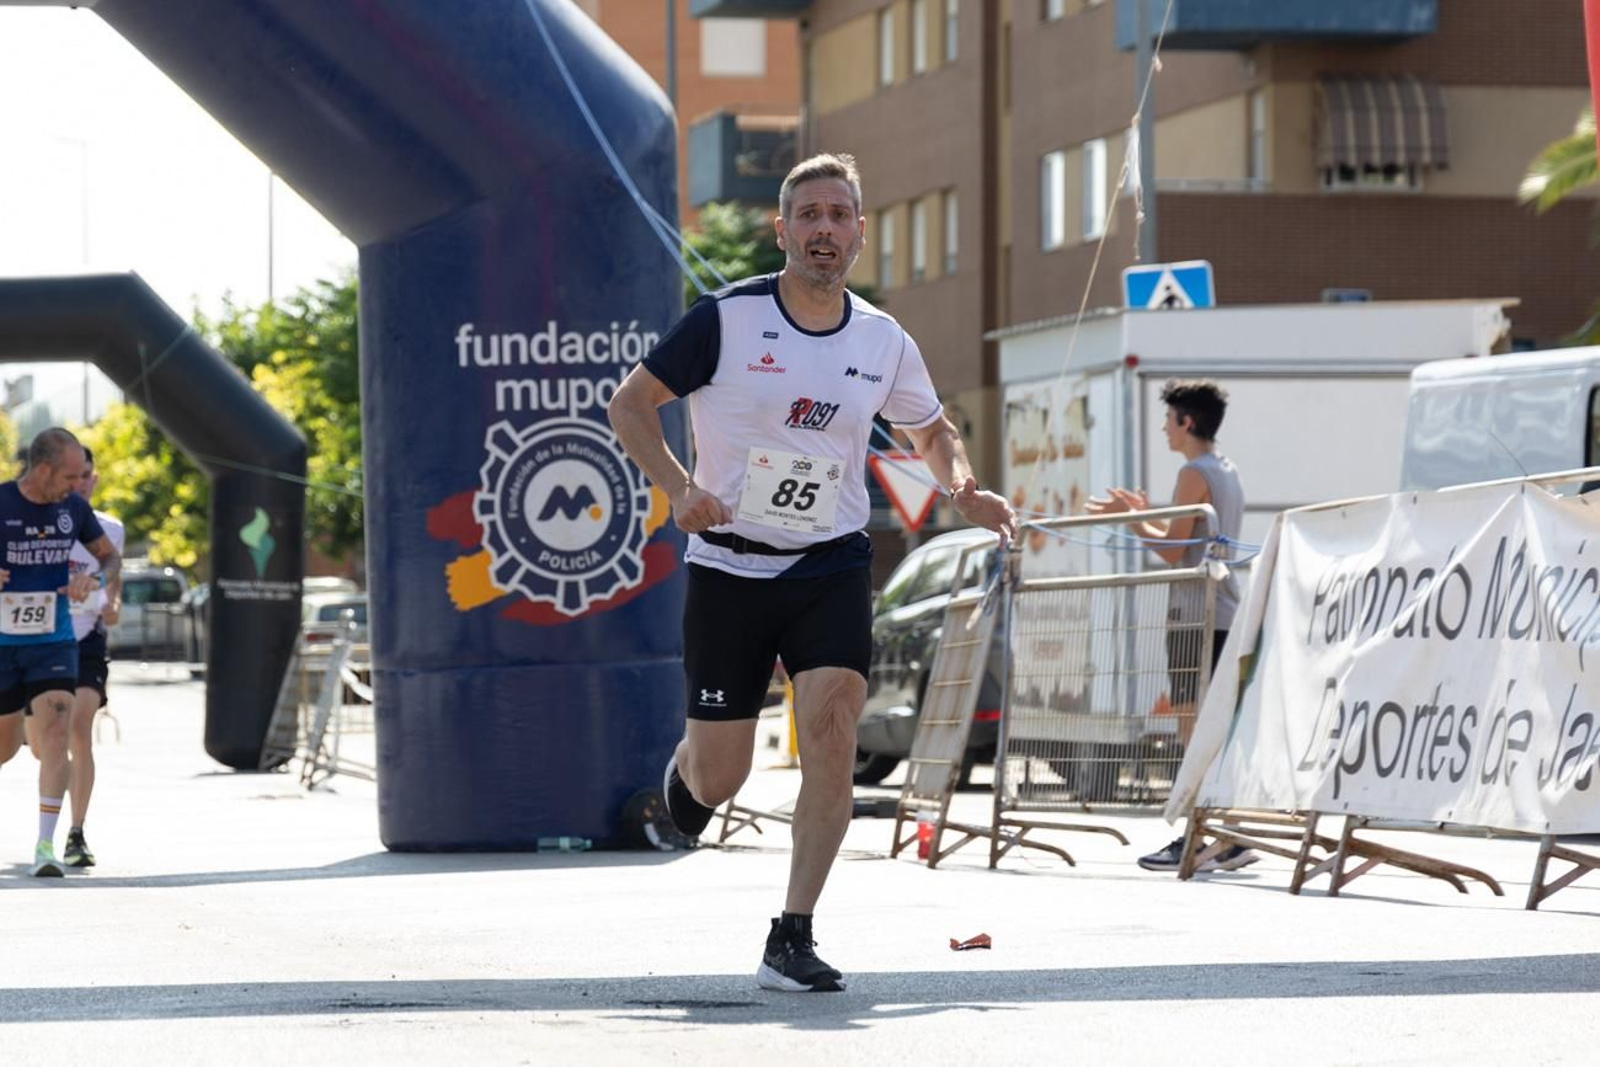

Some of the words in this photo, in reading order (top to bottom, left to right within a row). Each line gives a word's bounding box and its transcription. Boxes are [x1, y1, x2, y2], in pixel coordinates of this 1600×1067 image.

[747, 364, 786, 373] Santander
[534, 449, 550, 462] de
[551, 444, 564, 455] la
[566, 443, 621, 483] Mutualidad
[507, 461, 535, 519] Fundación
[614, 484, 625, 499] de
[771, 478, 821, 511] 85
[617, 502, 627, 515] la
[7, 541, 30, 551] CLUB
[538, 550, 602, 570] POLICÍA
[11, 606, 46, 624] 159
[1481, 679, 1533, 787] de
